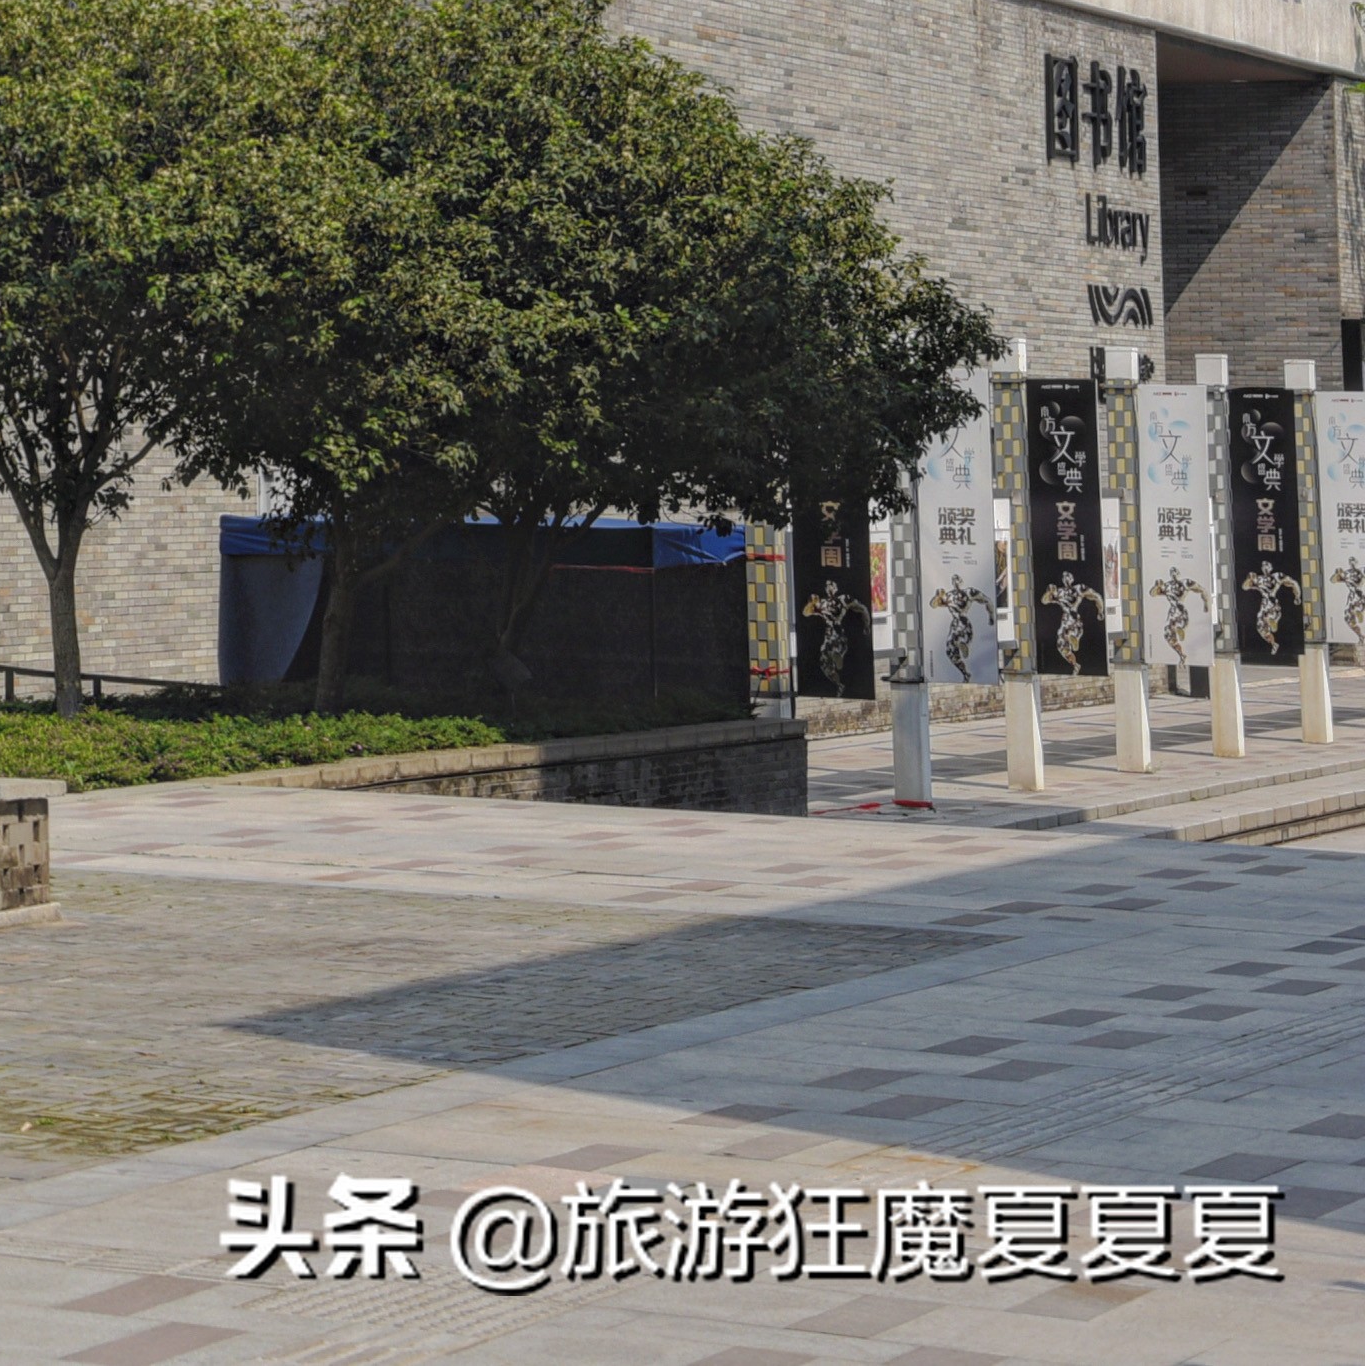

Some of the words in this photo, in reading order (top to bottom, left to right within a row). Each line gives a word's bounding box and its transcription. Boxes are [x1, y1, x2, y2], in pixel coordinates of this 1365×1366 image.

[1044, 53, 1148, 174] 图书馆
[1085, 192, 1150, 266] Library
